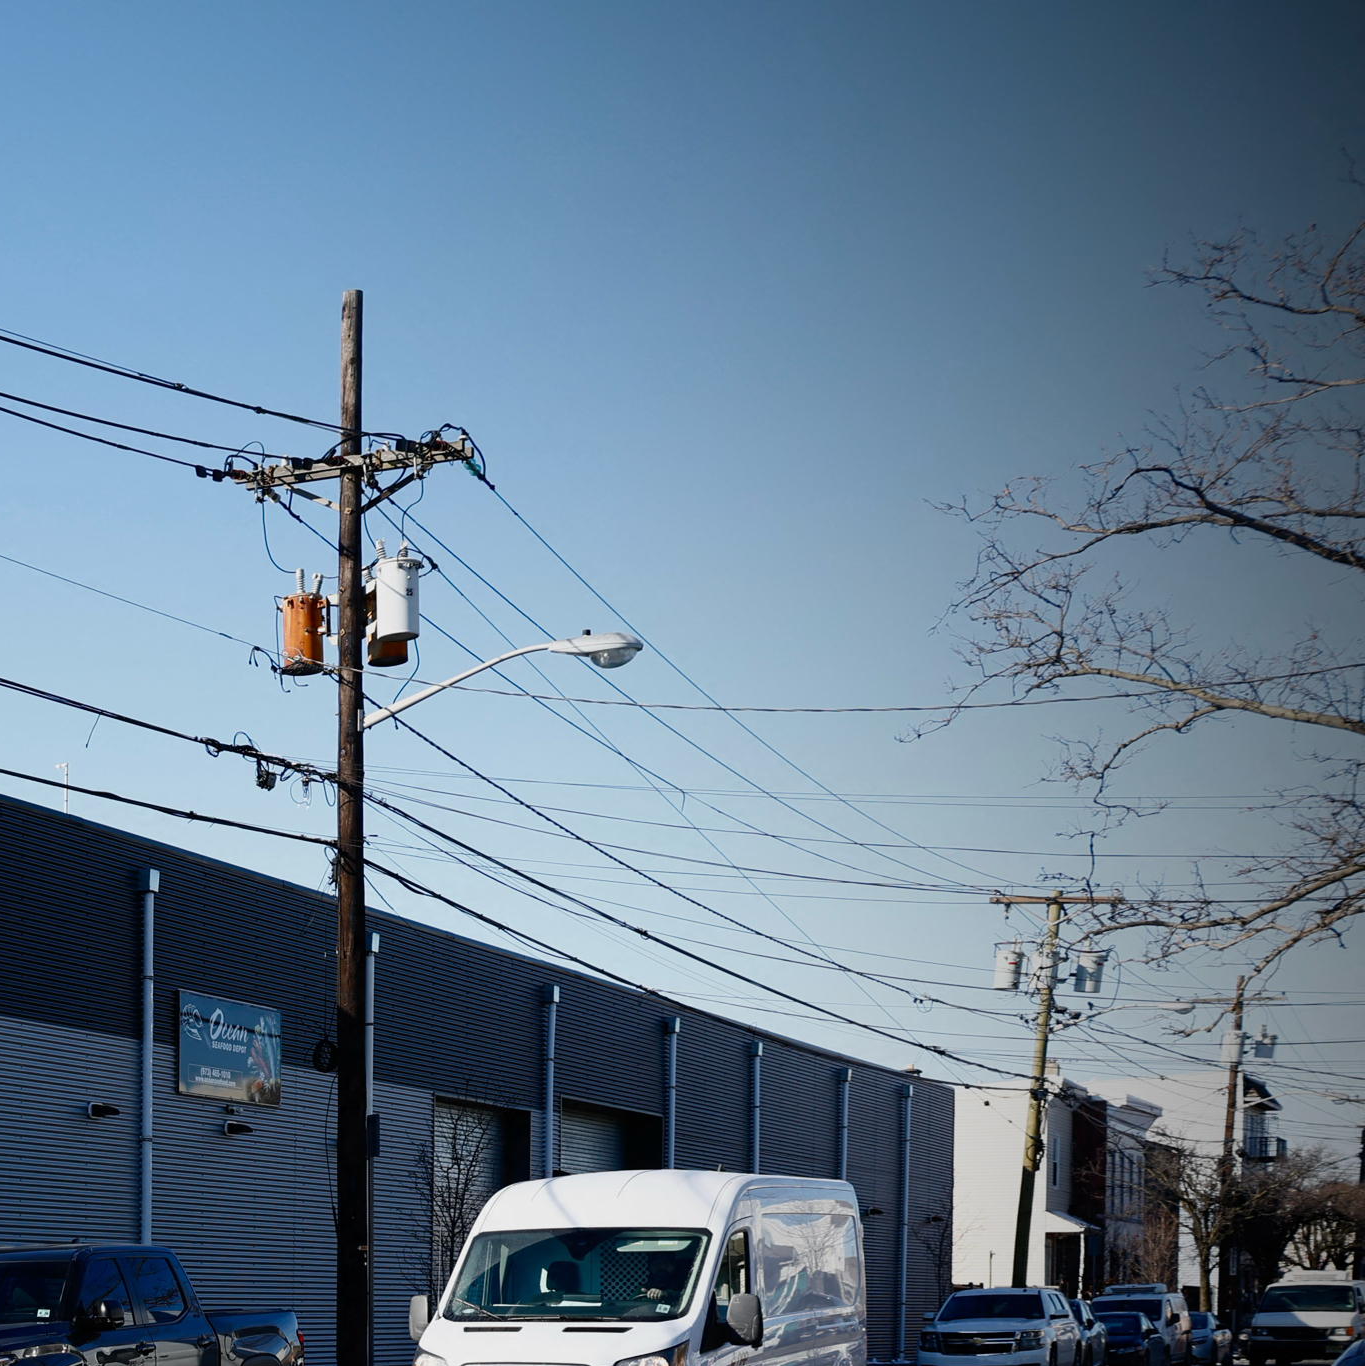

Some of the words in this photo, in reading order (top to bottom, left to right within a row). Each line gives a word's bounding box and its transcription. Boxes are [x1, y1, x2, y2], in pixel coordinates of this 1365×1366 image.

[209, 1008, 249, 1043] Ocean
[212, 1041, 232, 1051] SEAFOOD
[233, 1043, 247, 1053] DEPOT
